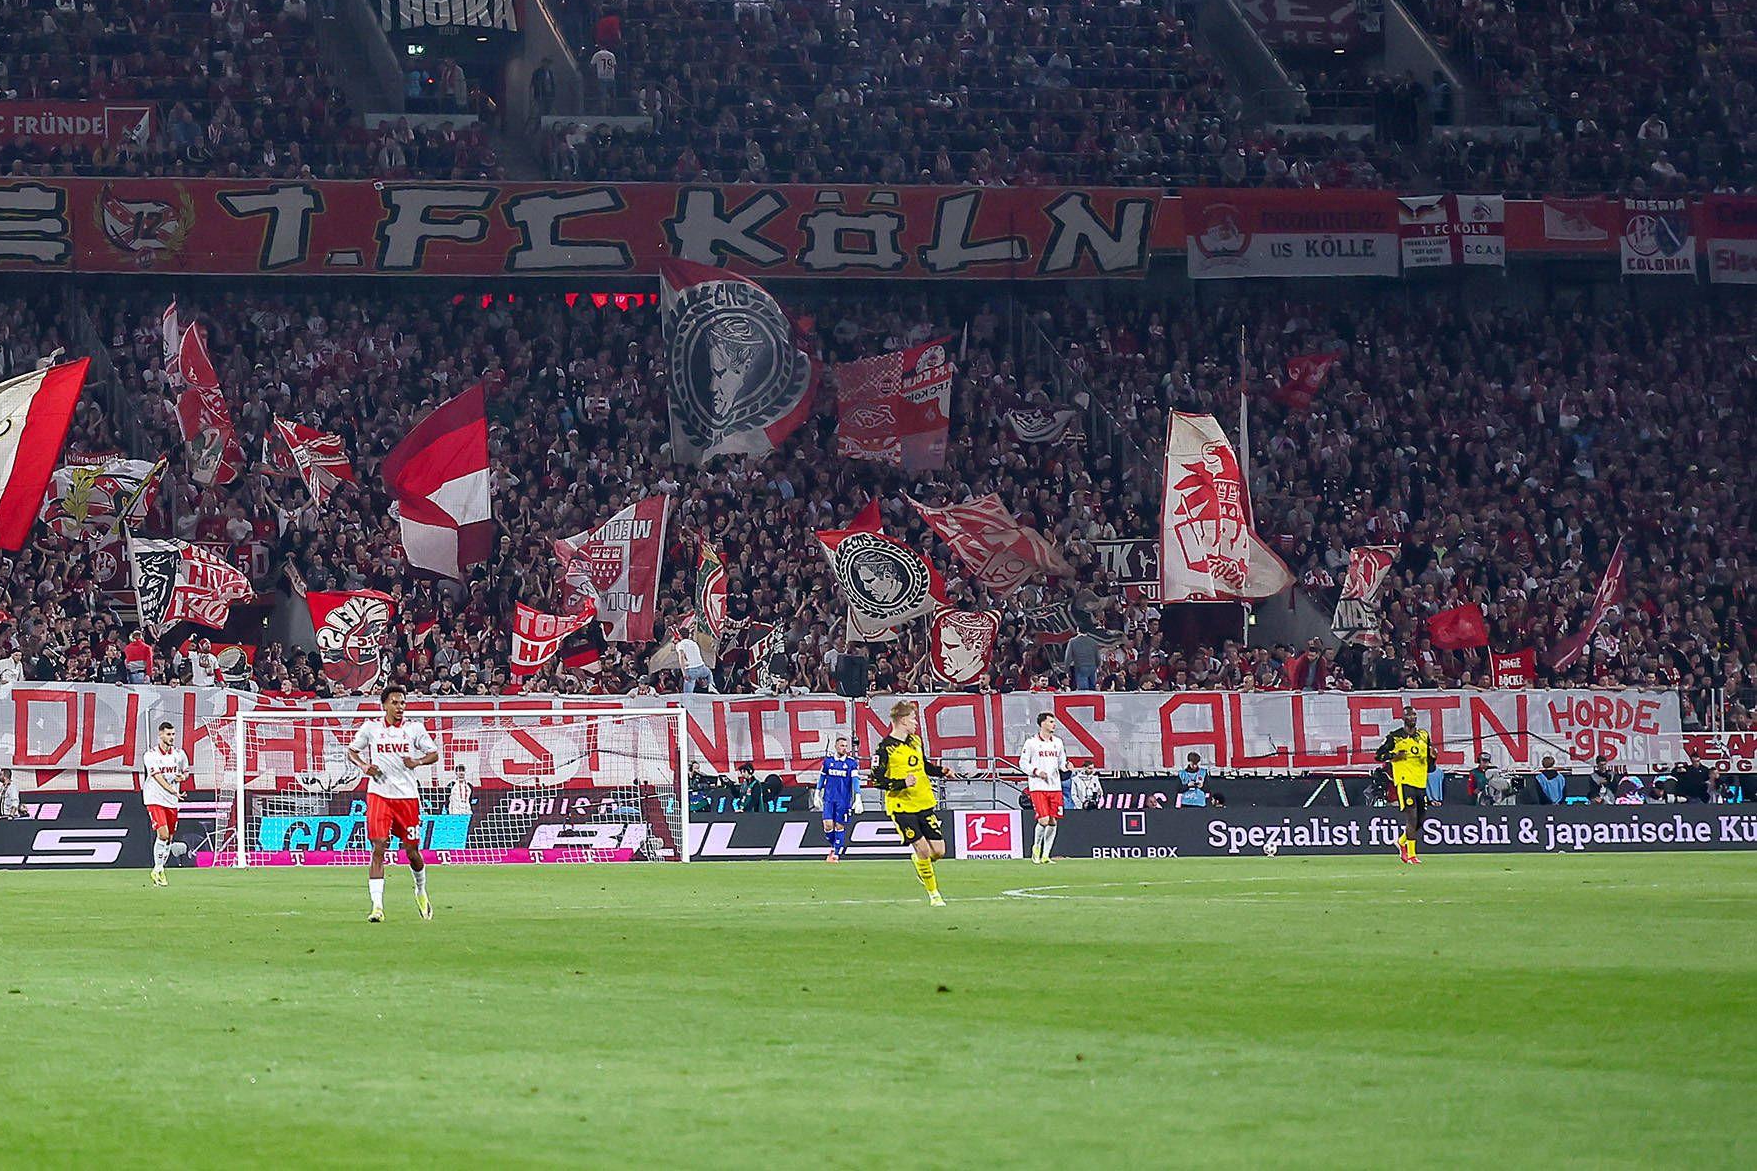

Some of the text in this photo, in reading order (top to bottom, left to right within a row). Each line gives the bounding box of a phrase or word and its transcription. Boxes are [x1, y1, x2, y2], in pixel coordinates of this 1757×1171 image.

[14, 111, 105, 135] FRÜNDE
[664, 187, 1154, 274] KÖLN
[1271, 235, 1376, 257] US KÖLLE
[12, 688, 139, 767] DU
[1158, 691, 1530, 770] ALLEIN
[1547, 695, 1661, 736] HORDE
[376, 742, 411, 754] REWE
[1207, 817, 1361, 853] Spezialist
[1423, 816, 1511, 845] Sushi
[1518, 818, 1540, 844] &
[1545, 815, 1712, 851] japanische
[1093, 847, 1178, 858] BENTO BOX
